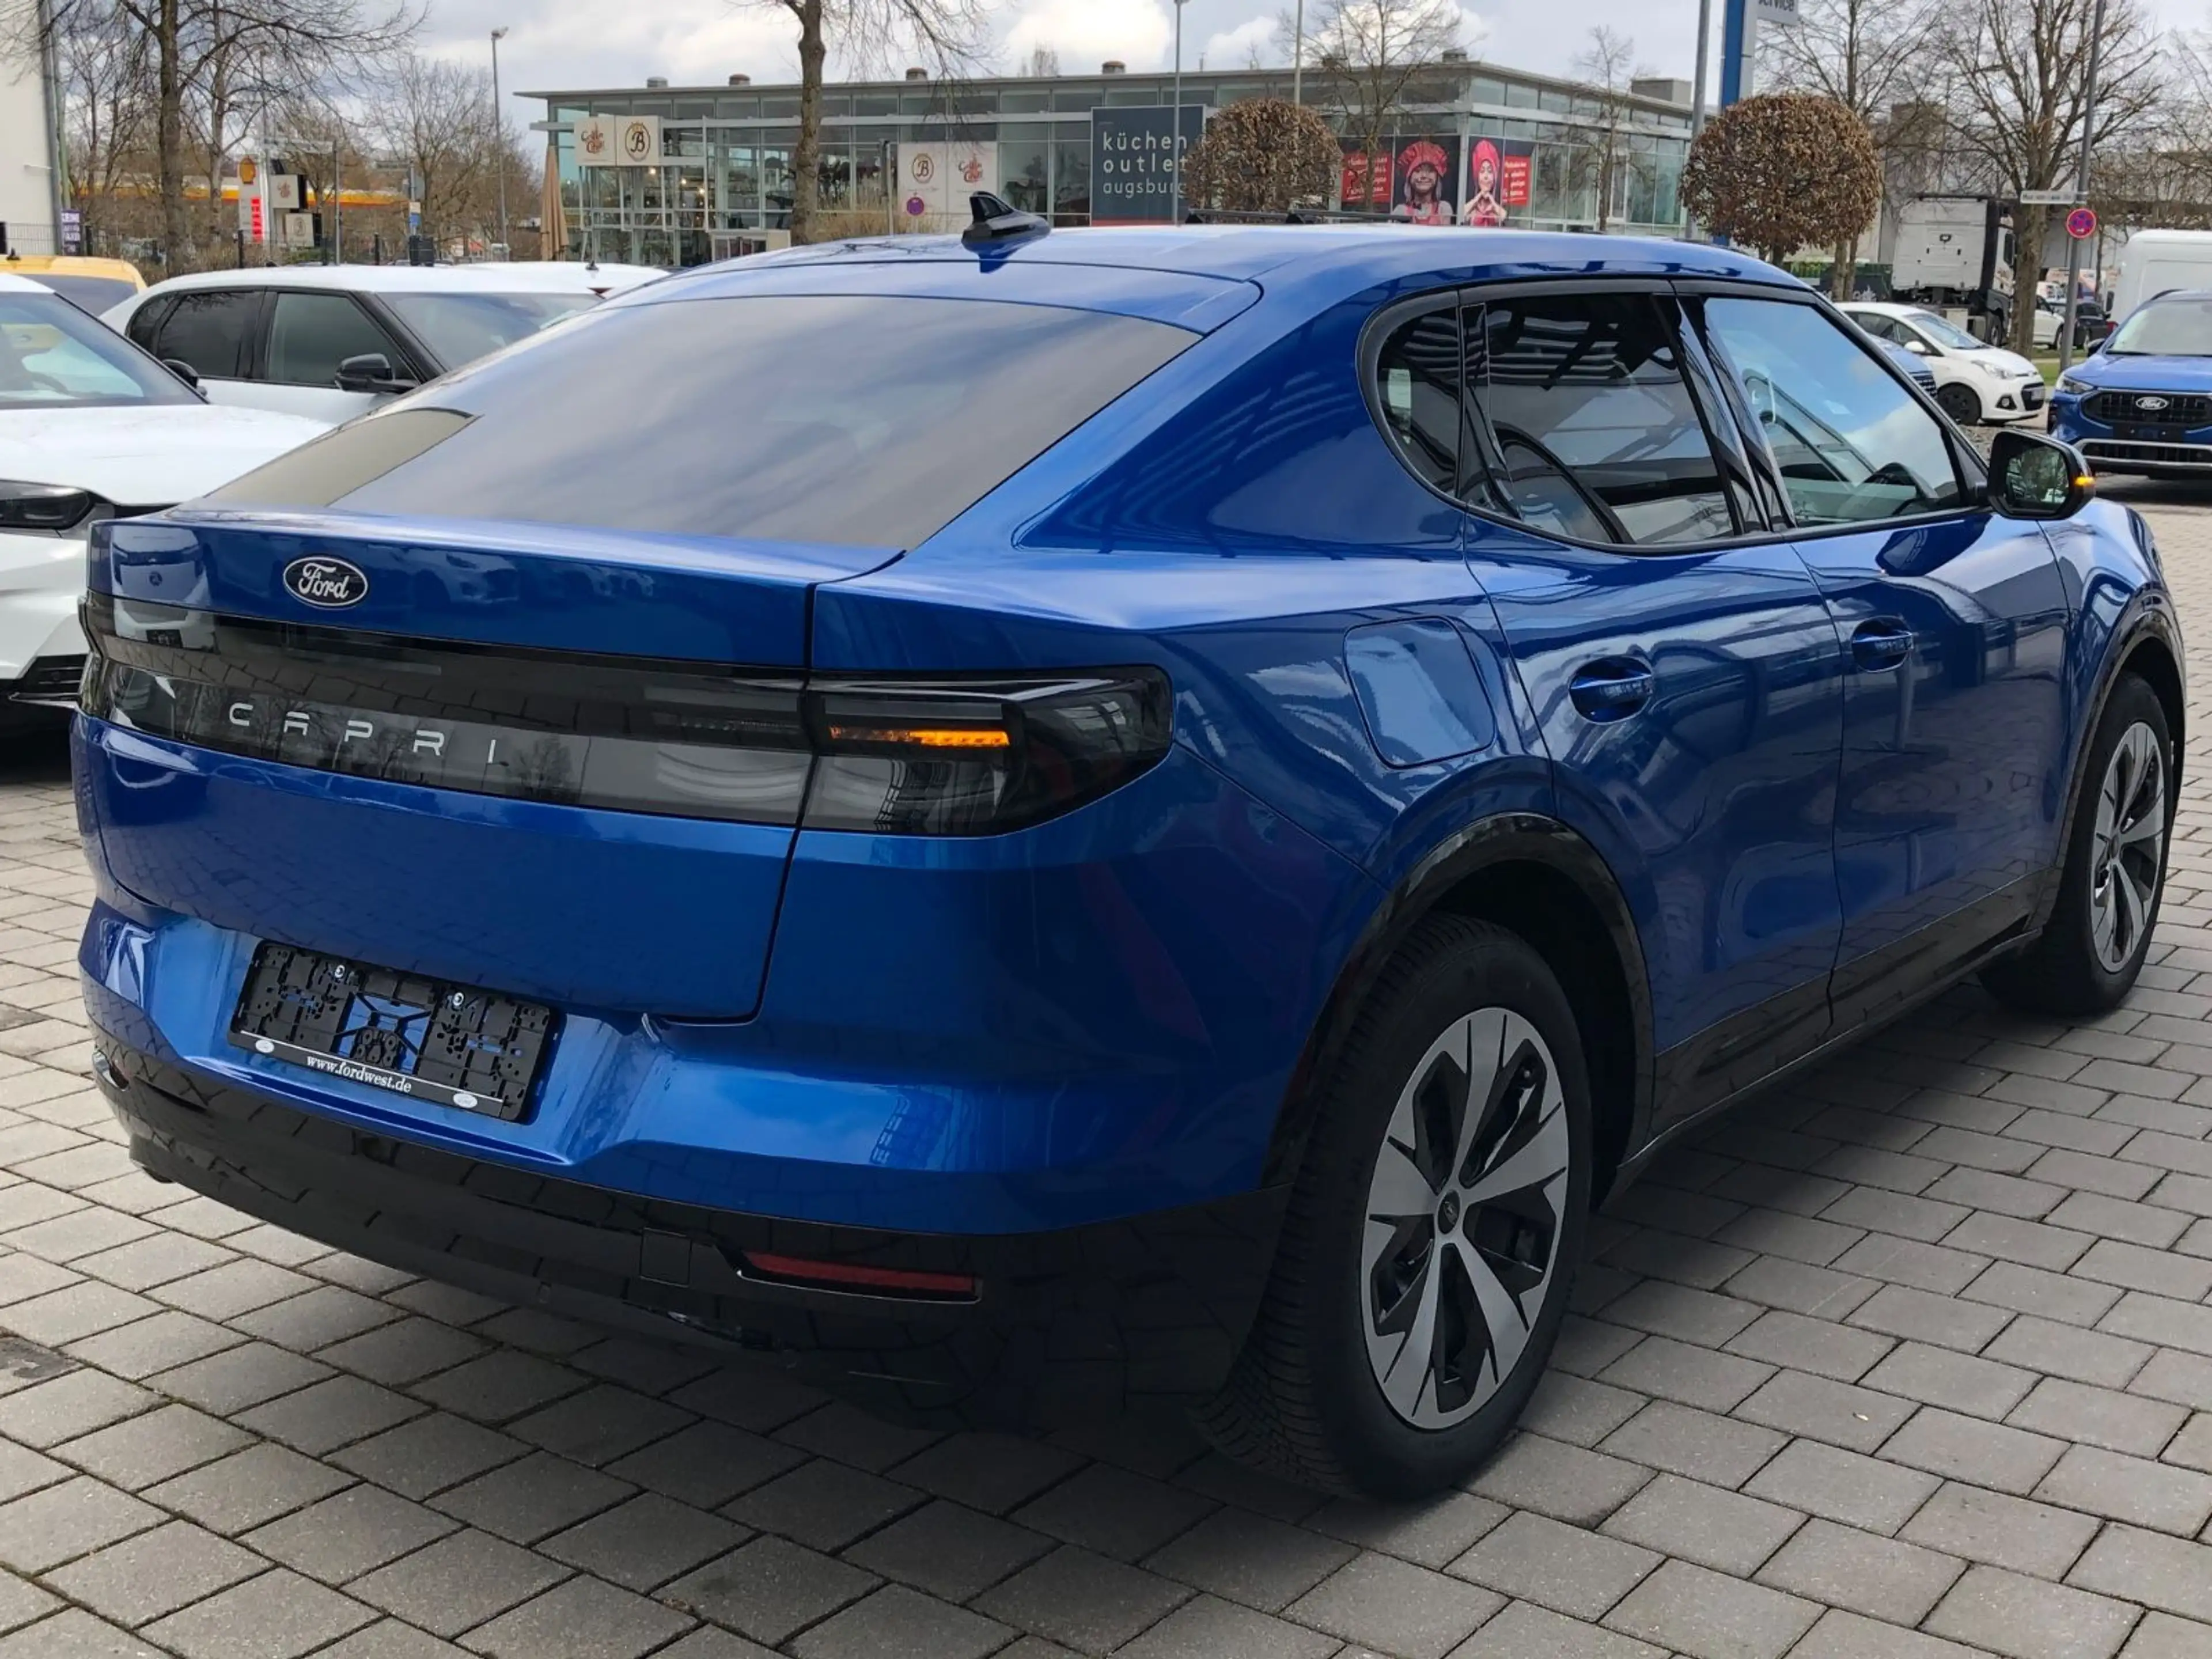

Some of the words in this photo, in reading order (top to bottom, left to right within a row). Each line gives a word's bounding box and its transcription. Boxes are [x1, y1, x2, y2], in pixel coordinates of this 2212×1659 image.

[631, 131, 645, 152] B
[1103, 130, 1187, 150] küchen
[916, 160, 929, 177] B
[1103, 153, 1188, 173] outlet
[298, 562, 350, 599] Ford
[229, 702, 497, 764] CAPRI
[306, 1056, 412, 1093] www.fordwest.de
